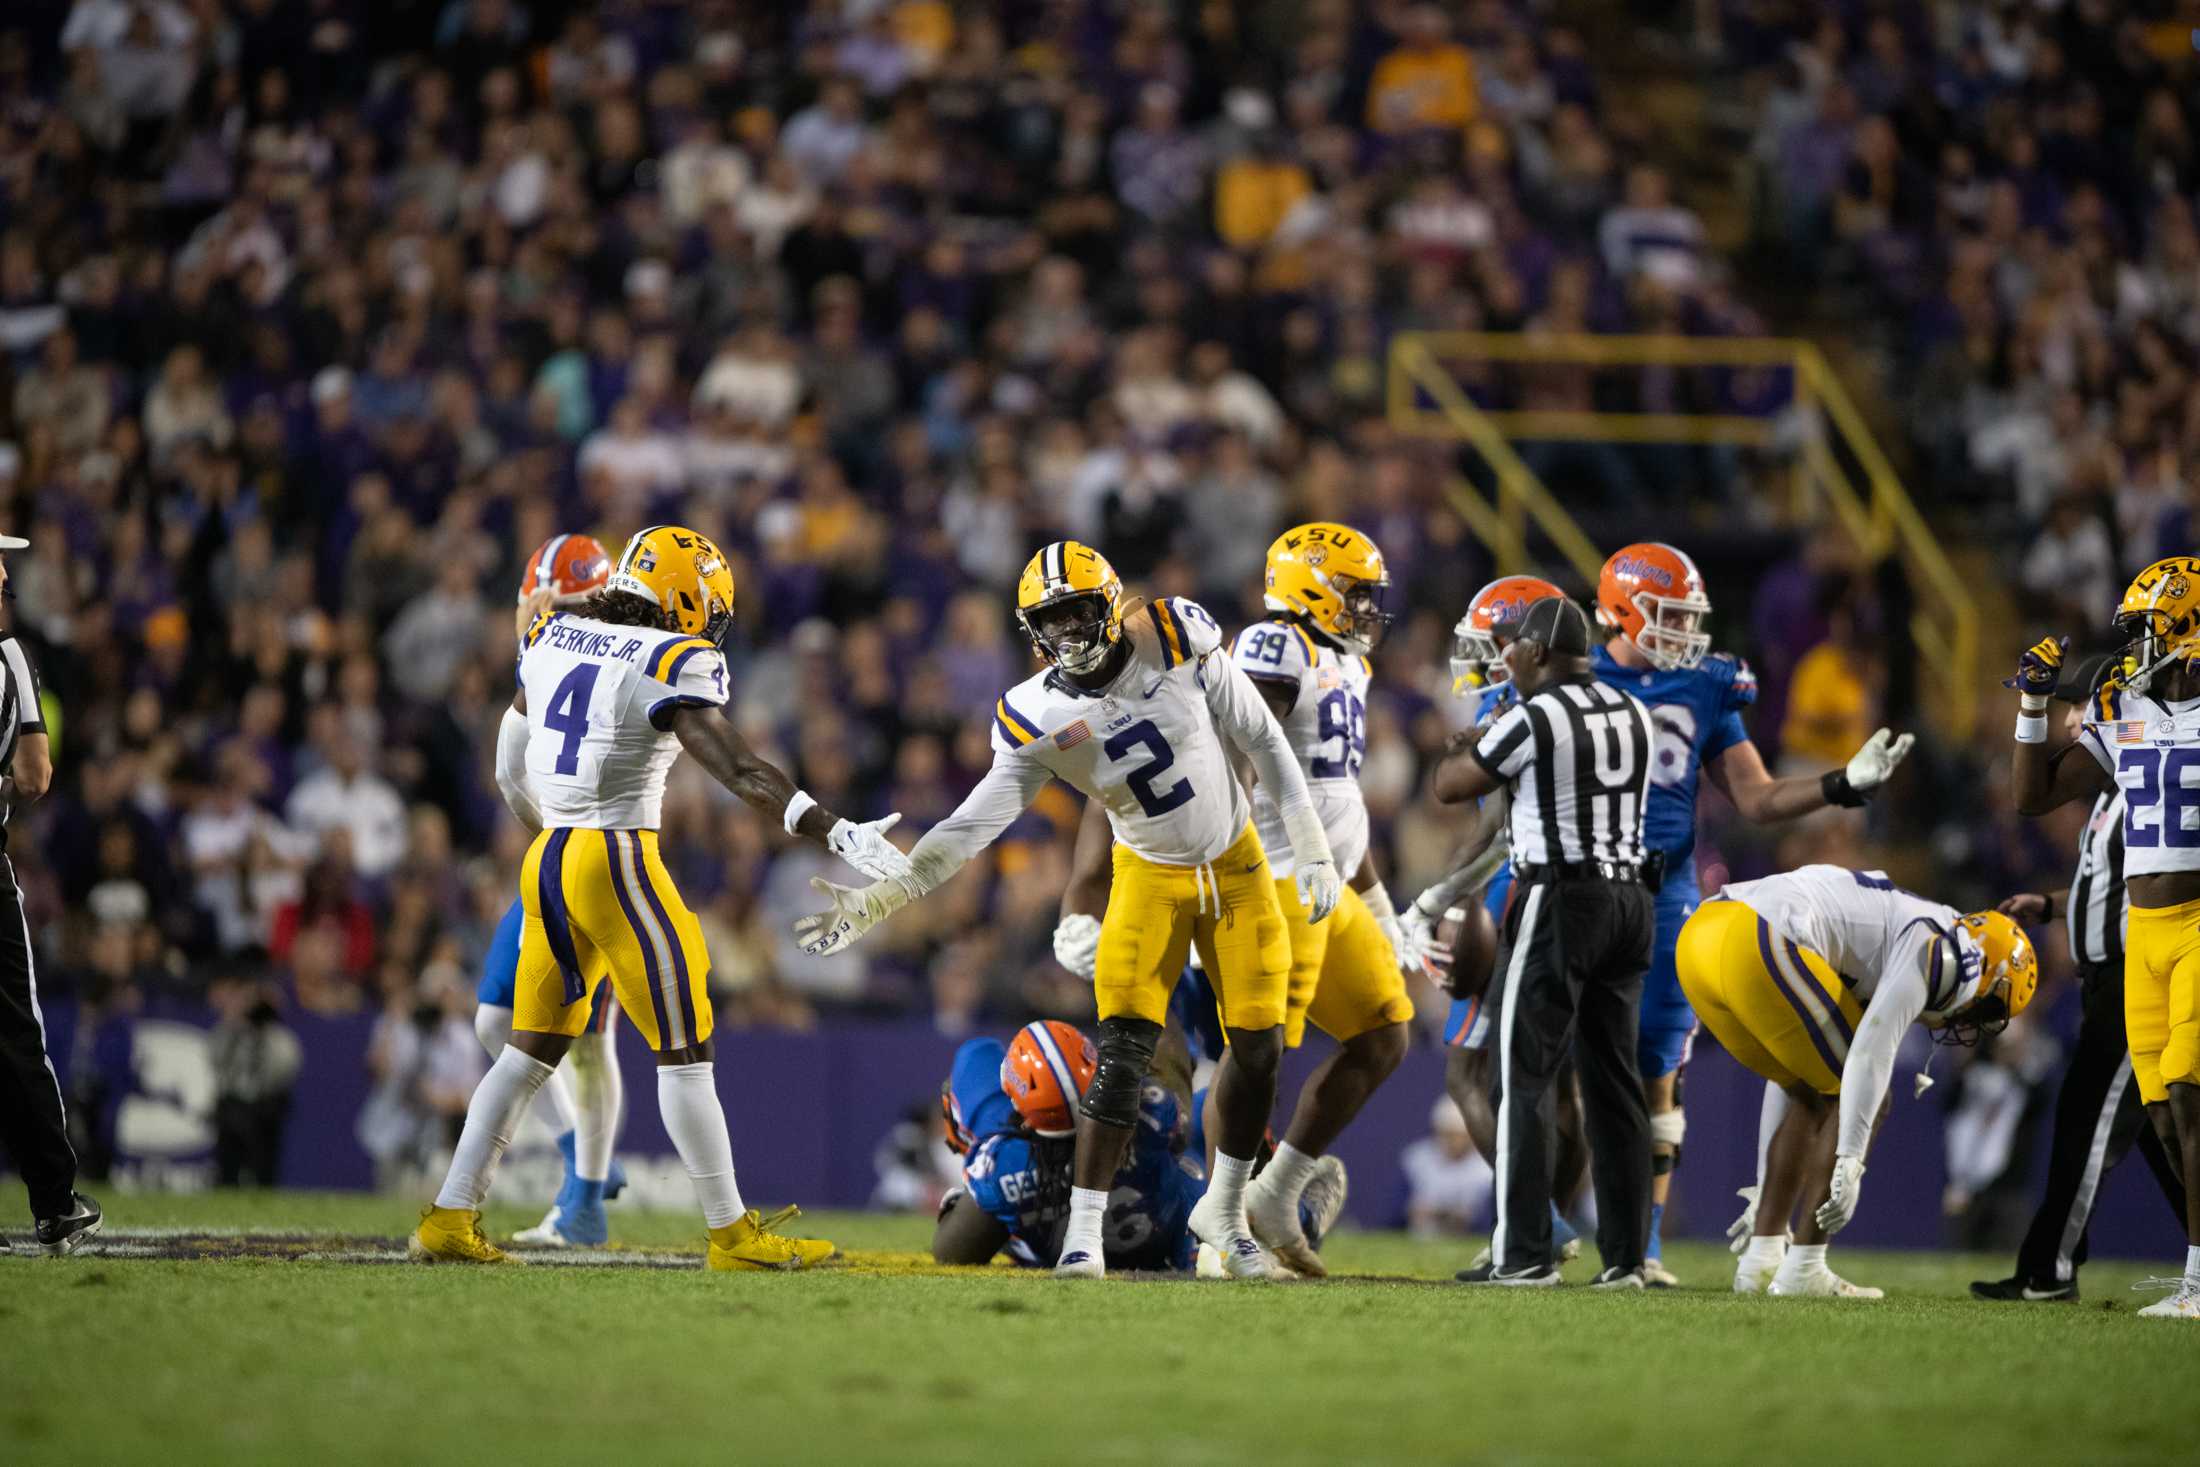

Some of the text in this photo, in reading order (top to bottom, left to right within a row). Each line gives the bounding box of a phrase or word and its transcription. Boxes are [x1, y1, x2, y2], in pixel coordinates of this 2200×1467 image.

[1285, 527, 1352, 550] LSU
[545, 624, 643, 662] PERKINS JR.
[1184, 604, 1217, 631] 2
[1245, 630, 1287, 667] 99
[544, 662, 602, 777] 4
[1107, 713, 1133, 731] LSU
[1311, 688, 1367, 780] 99
[1583, 709, 1635, 788] U
[1103, 719, 1196, 818] 2
[2117, 748, 2200, 848] 26
